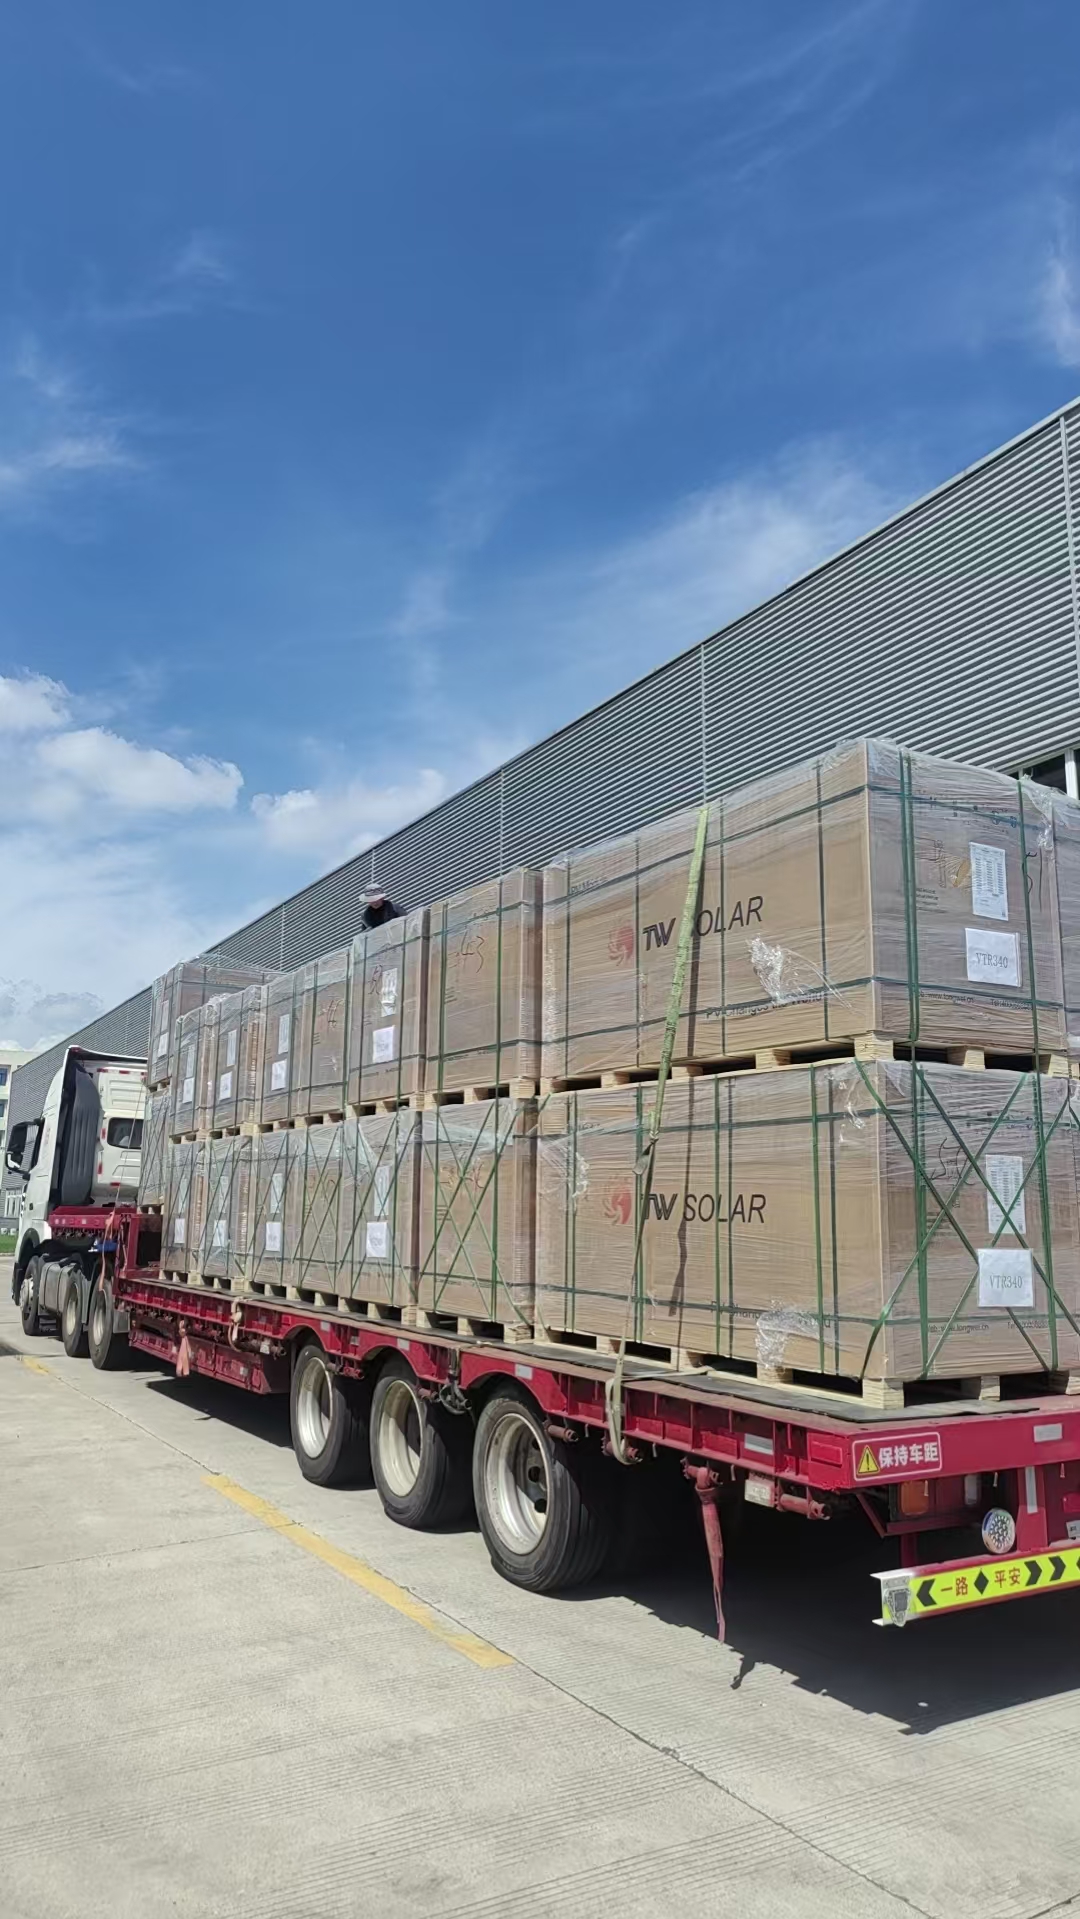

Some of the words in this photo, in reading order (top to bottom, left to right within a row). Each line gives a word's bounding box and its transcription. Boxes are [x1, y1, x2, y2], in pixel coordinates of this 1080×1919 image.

[689, 895, 764, 937] OLAR
[975, 952, 1009, 968] VTR340
[683, 1193, 767, 1224] SOLAR
[989, 1275, 1023, 1289] VTR340
[878, 1441, 939, 1469] 保持车距
[940, 1576, 968, 1597] 一路
[994, 1567, 1021, 1589] 平安
